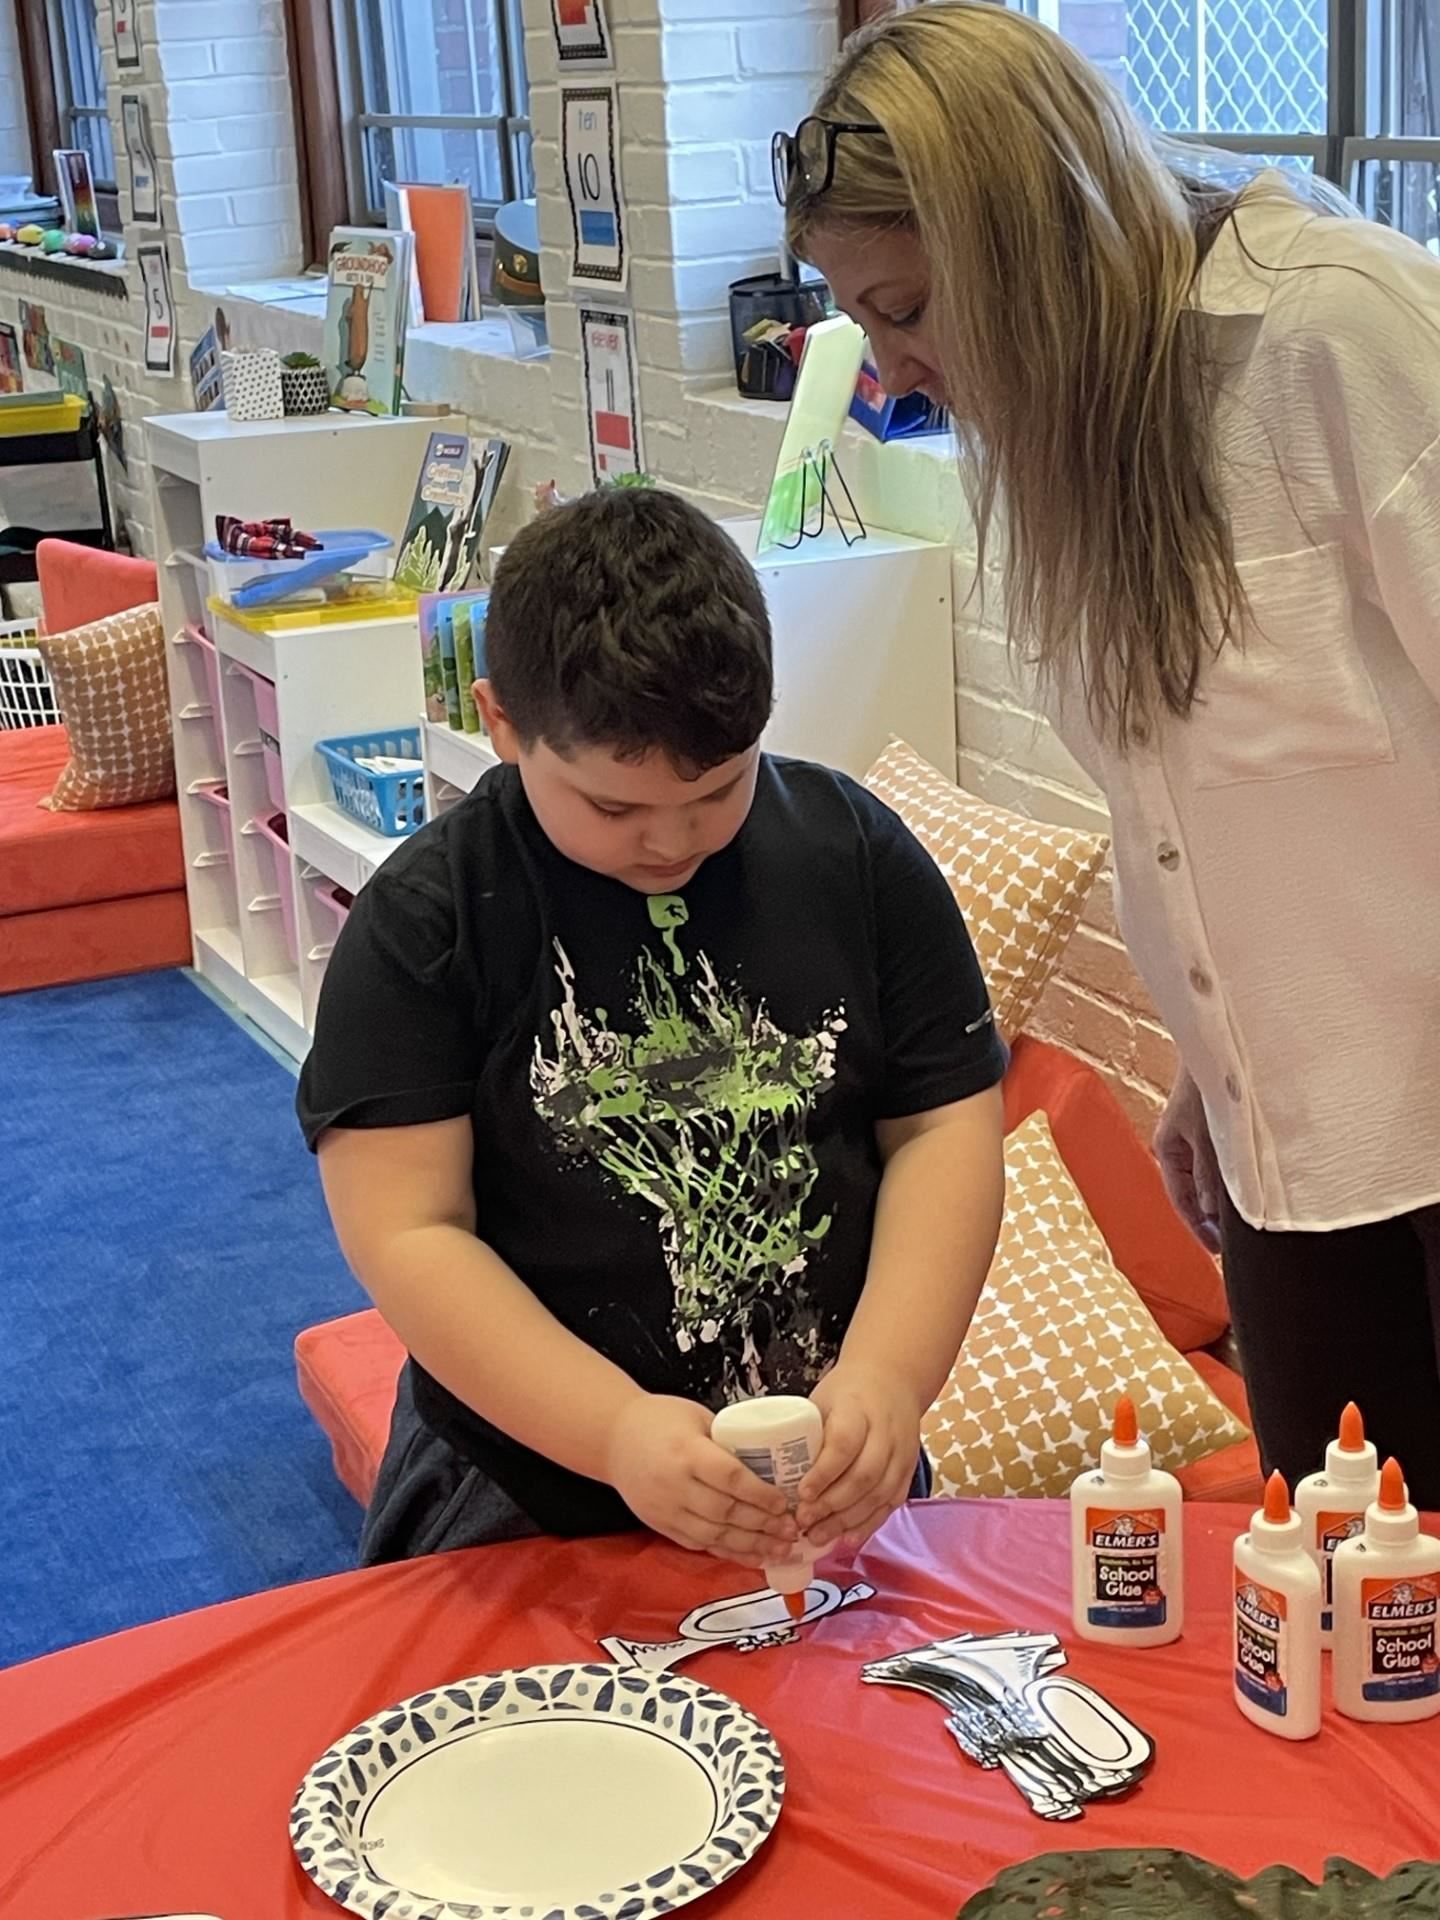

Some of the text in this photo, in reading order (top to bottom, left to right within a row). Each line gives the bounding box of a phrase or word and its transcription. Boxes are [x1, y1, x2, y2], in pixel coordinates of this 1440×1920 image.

[577, 152, 600, 201] 10
[336, 255, 388, 277] GROUNDHOG
[153, 287, 164, 320] 5
[605, 367, 616, 413] 11
[1094, 1533, 1159, 1549] ELMER'S
[1099, 1565, 1154, 1582] School
[1105, 1581, 1142, 1597] Glue
[1371, 1600, 1436, 1619] ELMER'S
[1239, 1629, 1275, 1665] School
[1375, 1631, 1432, 1654] School
[1240, 1647, 1265, 1675] Glue
[1382, 1652, 1420, 1669] Glue
